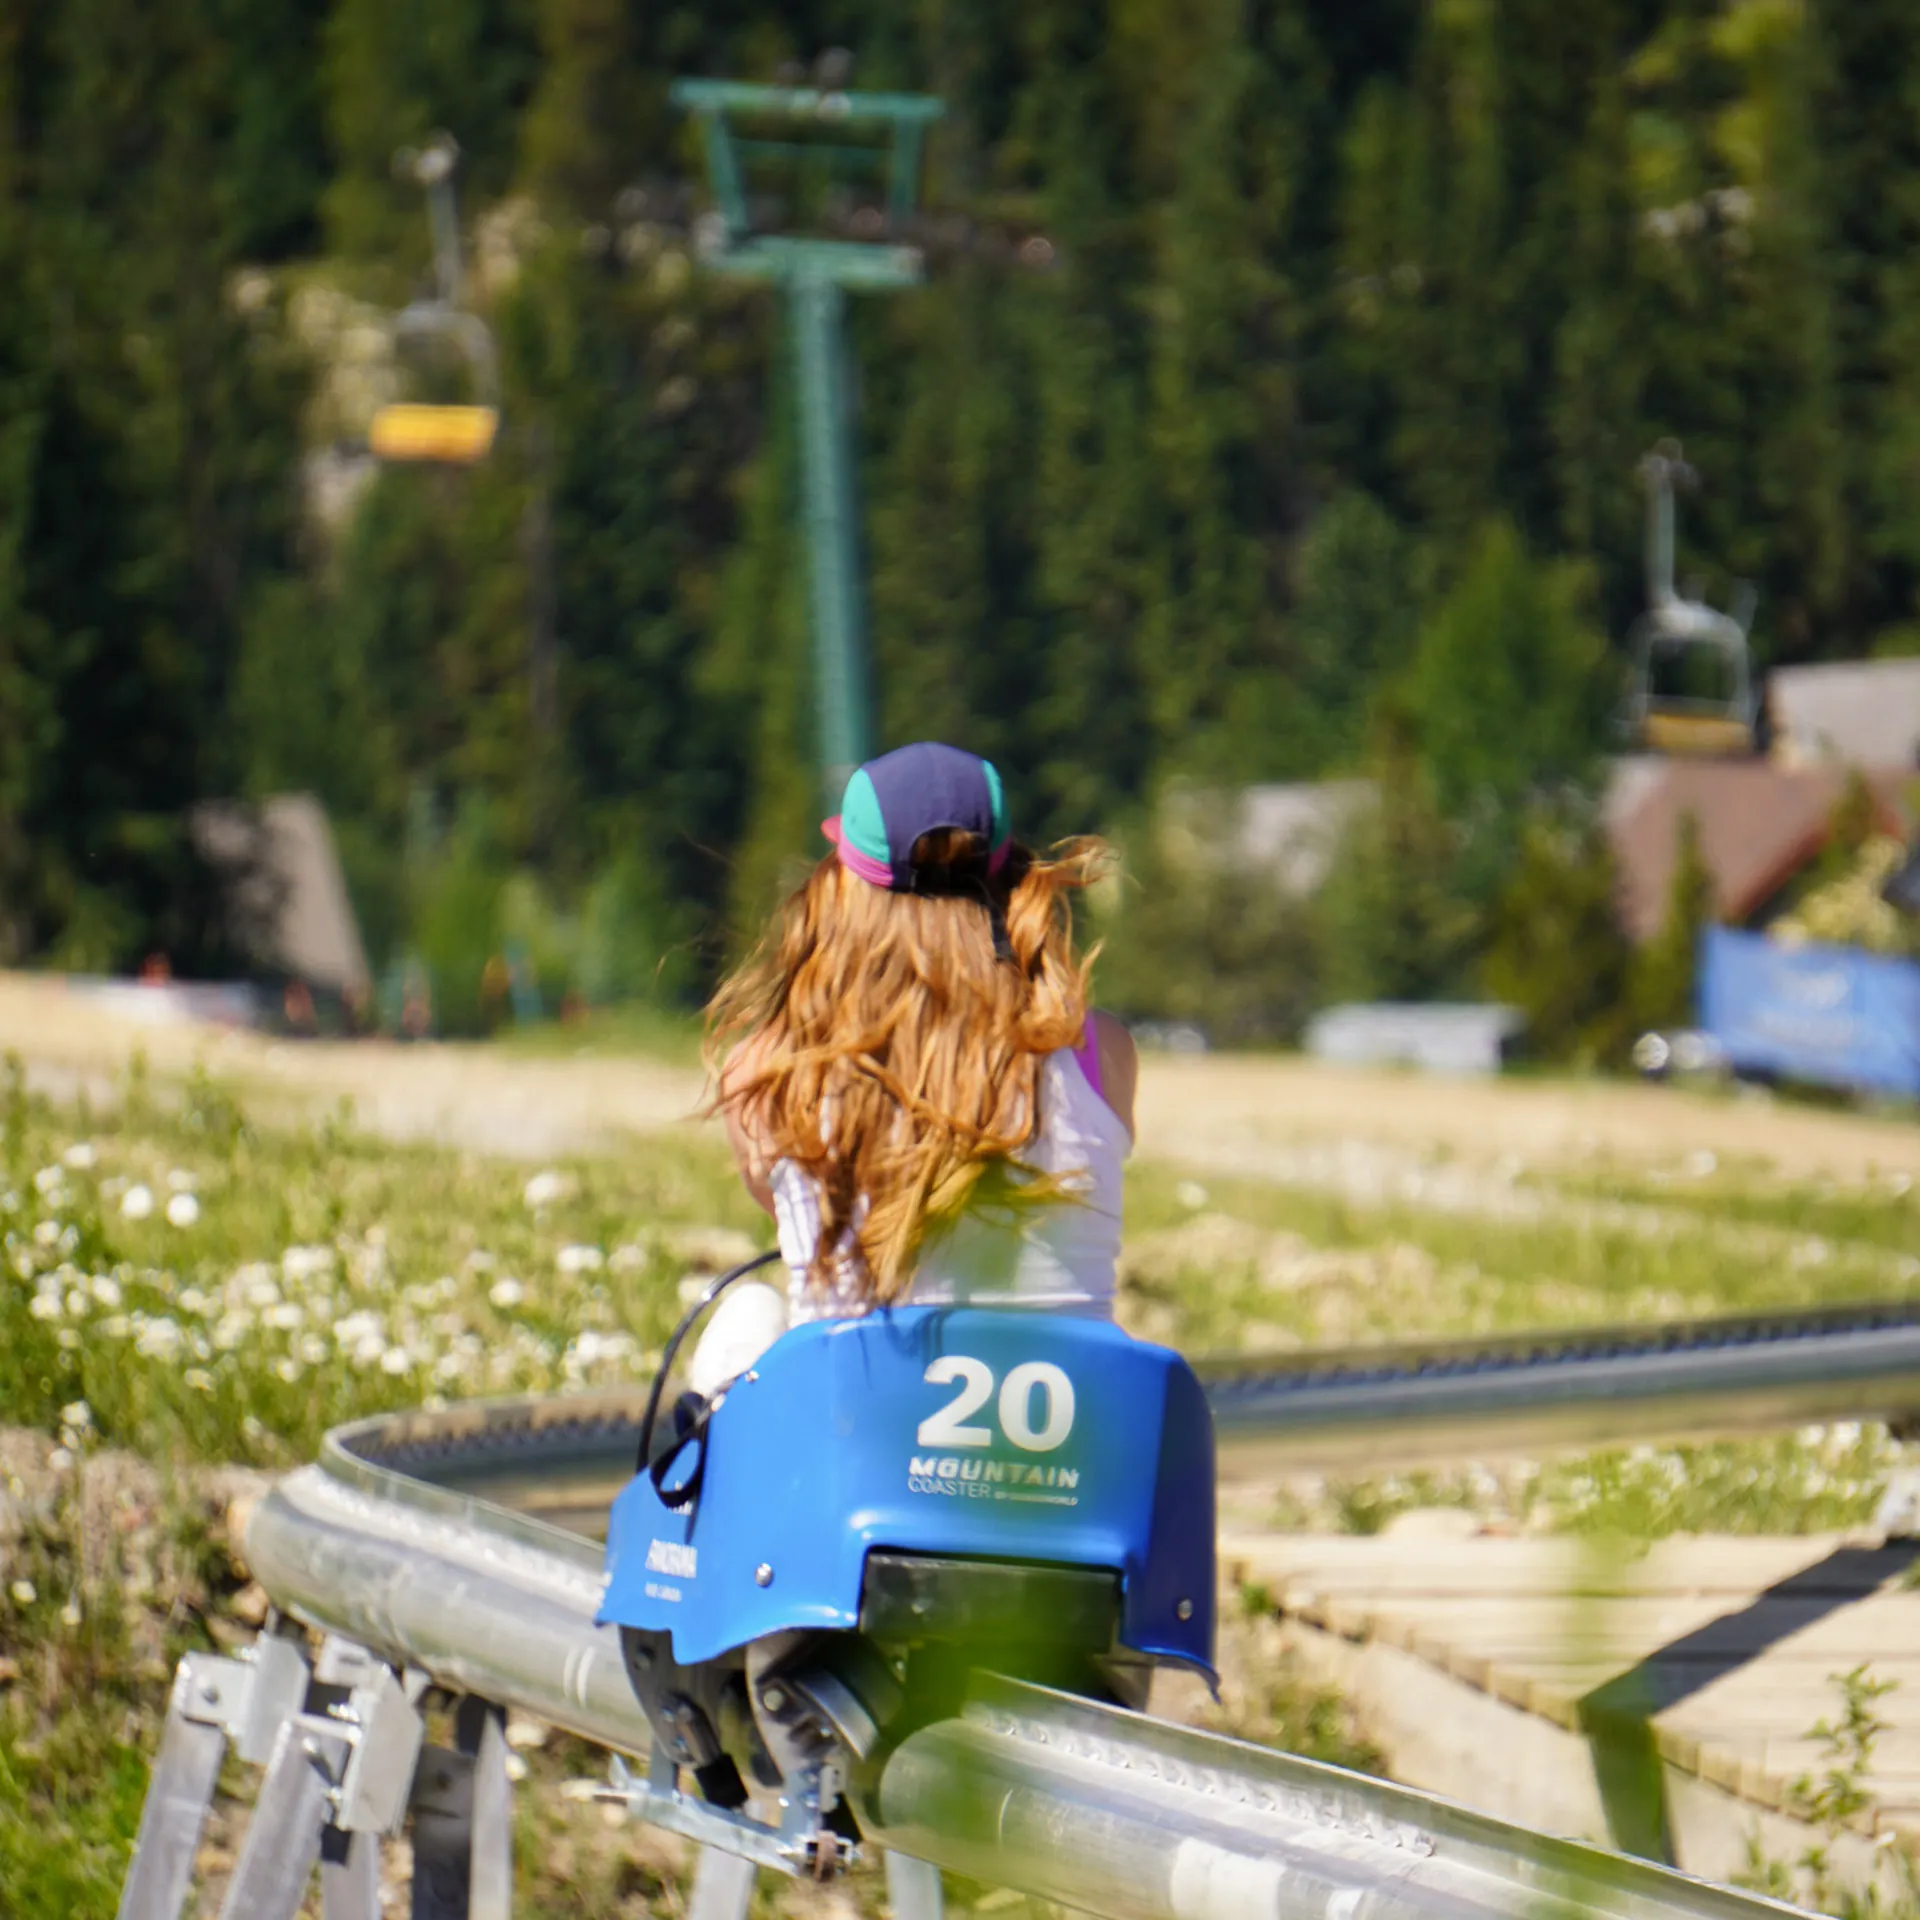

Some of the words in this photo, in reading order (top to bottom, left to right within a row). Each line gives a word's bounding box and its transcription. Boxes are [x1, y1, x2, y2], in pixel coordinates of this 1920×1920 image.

[917, 1355, 1076, 1452] 20
[907, 1477, 991, 1499] COASTER
[908, 1456, 1080, 1489] MOUNTAIN
